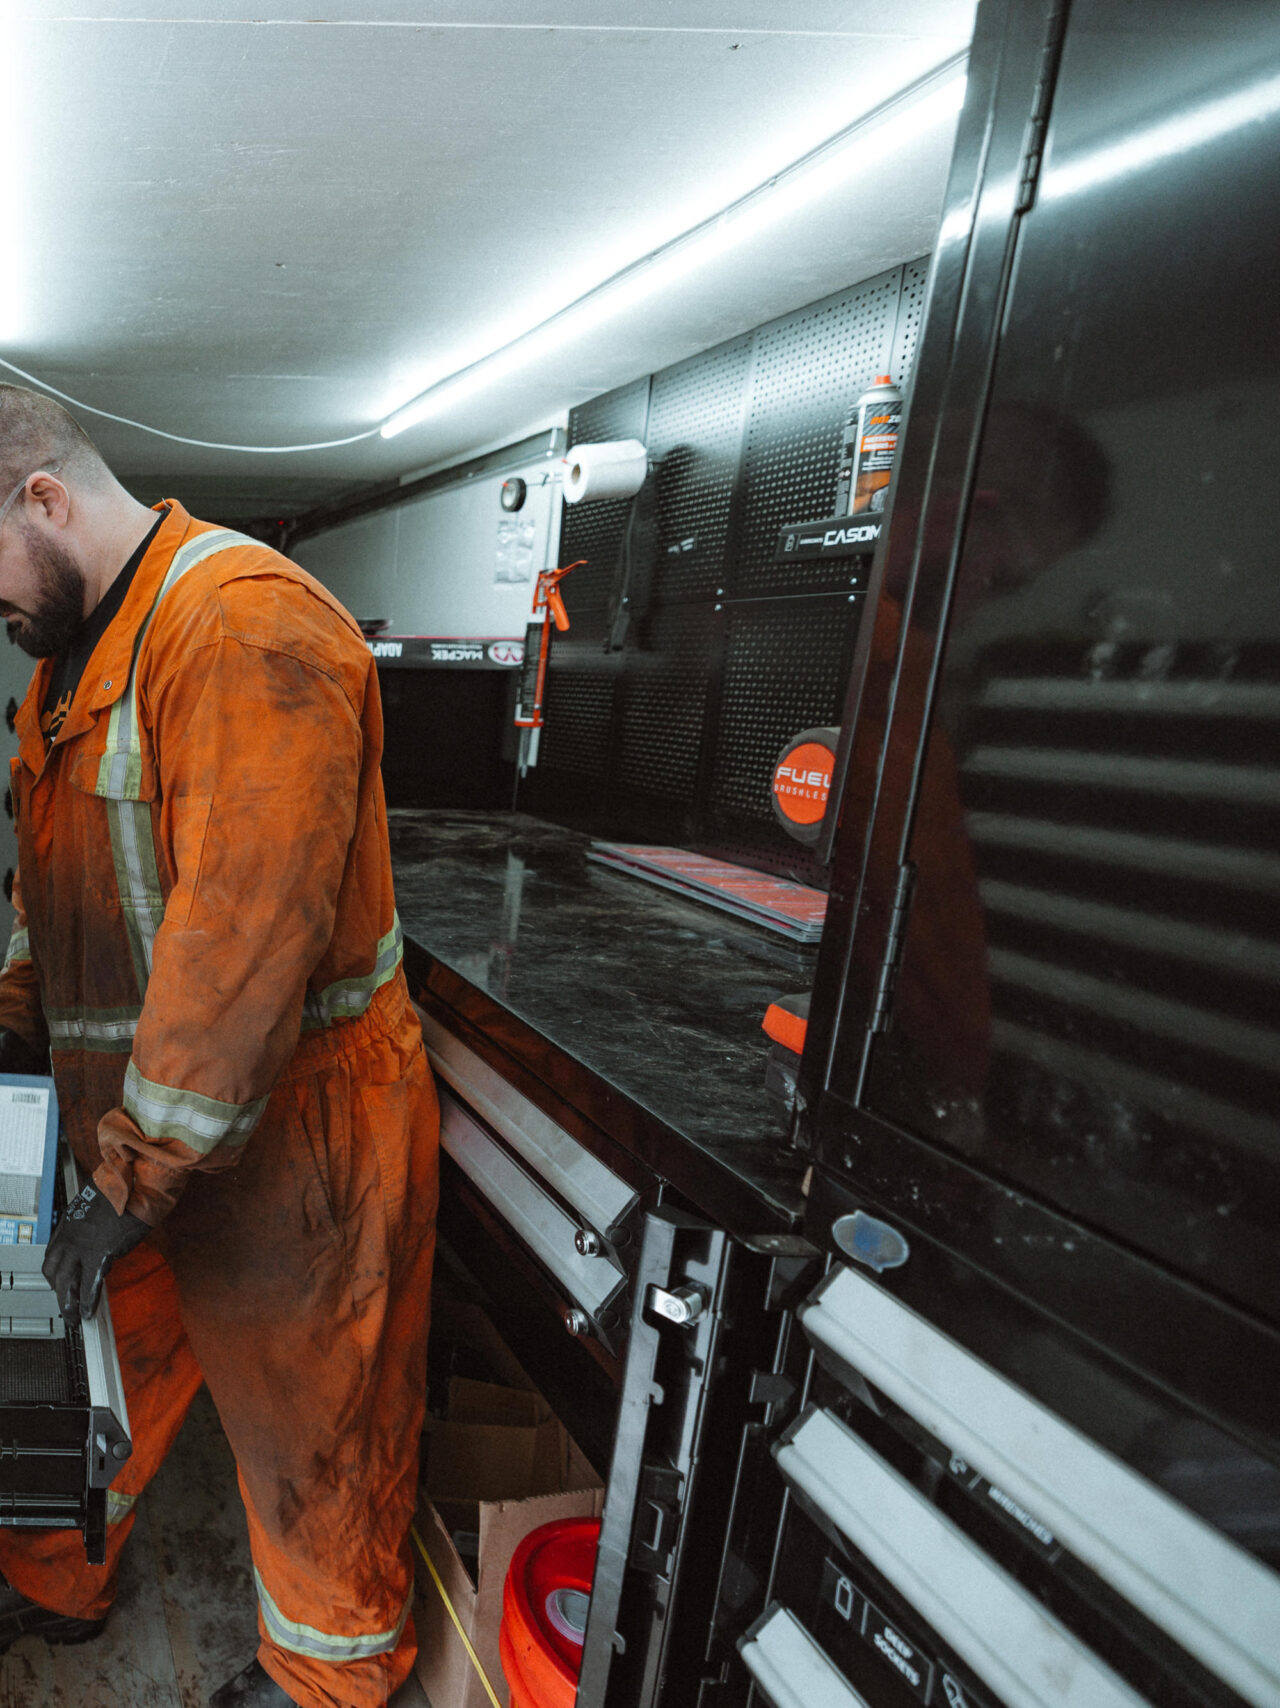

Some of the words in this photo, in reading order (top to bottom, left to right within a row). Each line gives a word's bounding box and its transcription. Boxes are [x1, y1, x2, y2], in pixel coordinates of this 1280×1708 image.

[366, 642, 403, 658] ADAPT
[431, 649, 483, 661] MACPEK
[776, 766, 831, 788] FUEL
[774, 784, 827, 802] BRUSHLES
